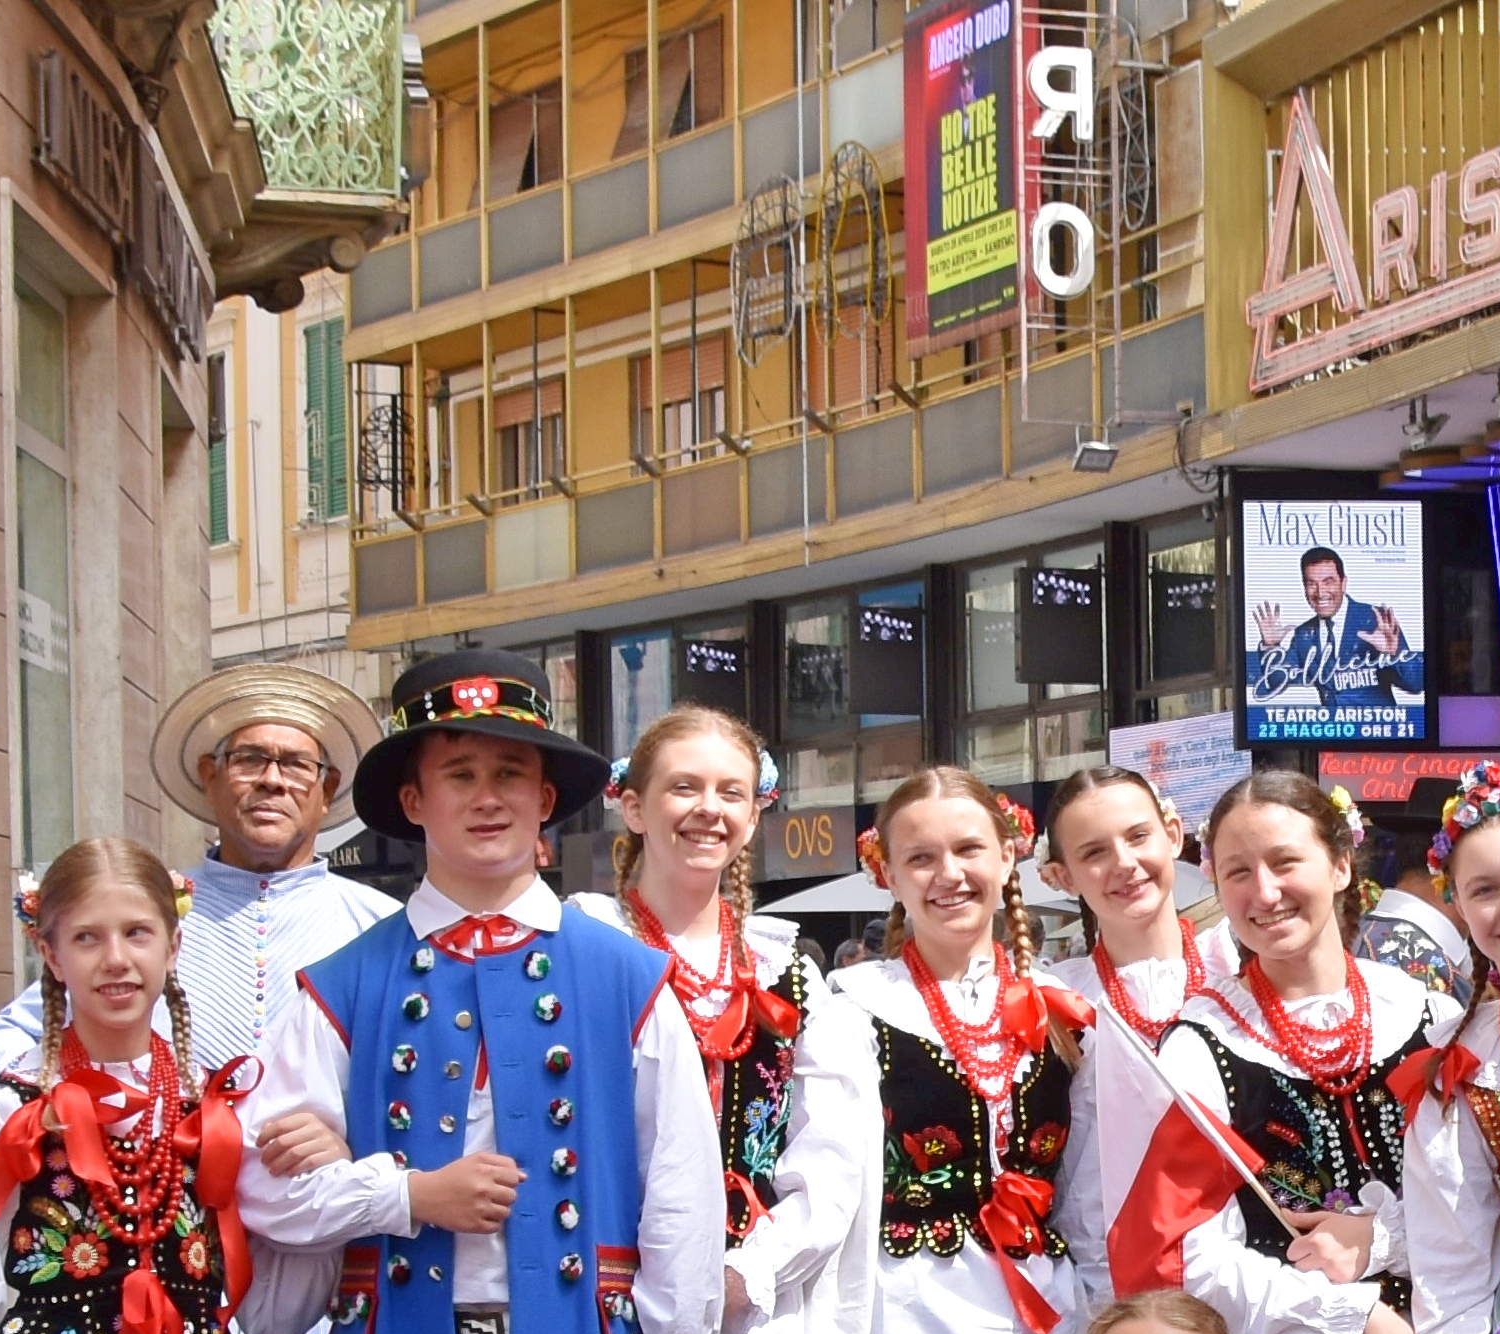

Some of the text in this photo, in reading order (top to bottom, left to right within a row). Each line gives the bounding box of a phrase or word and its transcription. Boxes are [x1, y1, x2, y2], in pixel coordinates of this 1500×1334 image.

[929, 0, 1010, 72] ANGELO DURO
[941, 93, 996, 154] HO TRE
[942, 133, 997, 193] BELLE
[943, 173, 998, 232] NOTIZIE
[1259, 503, 1407, 547] Max Giusti
[1253, 643, 1418, 702] Bollicine
[1334, 669, 1378, 690] UPDATE
[1258, 724, 1415, 738] 22 MAGGIO ORE 21
[1266, 708, 1407, 723] TEATRO ARISTON
[1321, 753, 1477, 775] Teatro Cine
[785, 814, 833, 860] OVS
